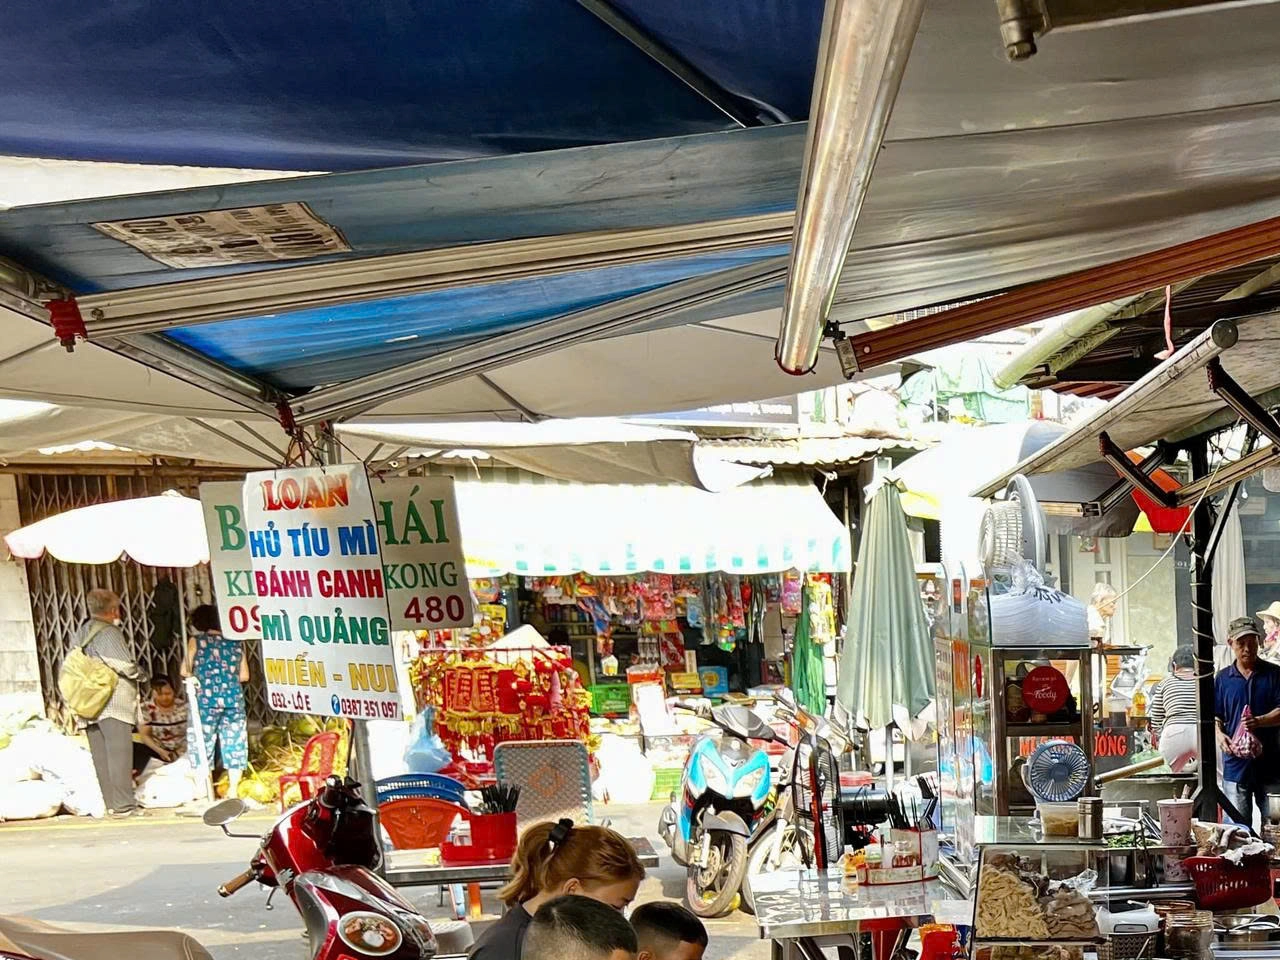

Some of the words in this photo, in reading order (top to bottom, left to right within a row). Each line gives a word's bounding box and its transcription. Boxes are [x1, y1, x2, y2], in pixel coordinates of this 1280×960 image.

[261, 474, 349, 512] LOAN
[249, 520, 281, 558] HỦ
[287, 518, 330, 558] TÍU
[338, 519, 378, 556] MÌ
[255, 565, 313, 598] BÁNH
[317, 568, 385, 598] CANH
[382, 561, 459, 590] KONG
[404, 594, 465, 624] 480
[261, 609, 292, 641] MÌ
[299, 607, 390, 646] QUẢNG
[265, 652, 328, 688] MIẾN
[348, 663, 398, 694] NUI
[271, 692, 287, 708] 032
[341, 698, 361, 716] 0387
[364, 699, 380, 717] 351
[381, 701, 398, 718] 097
